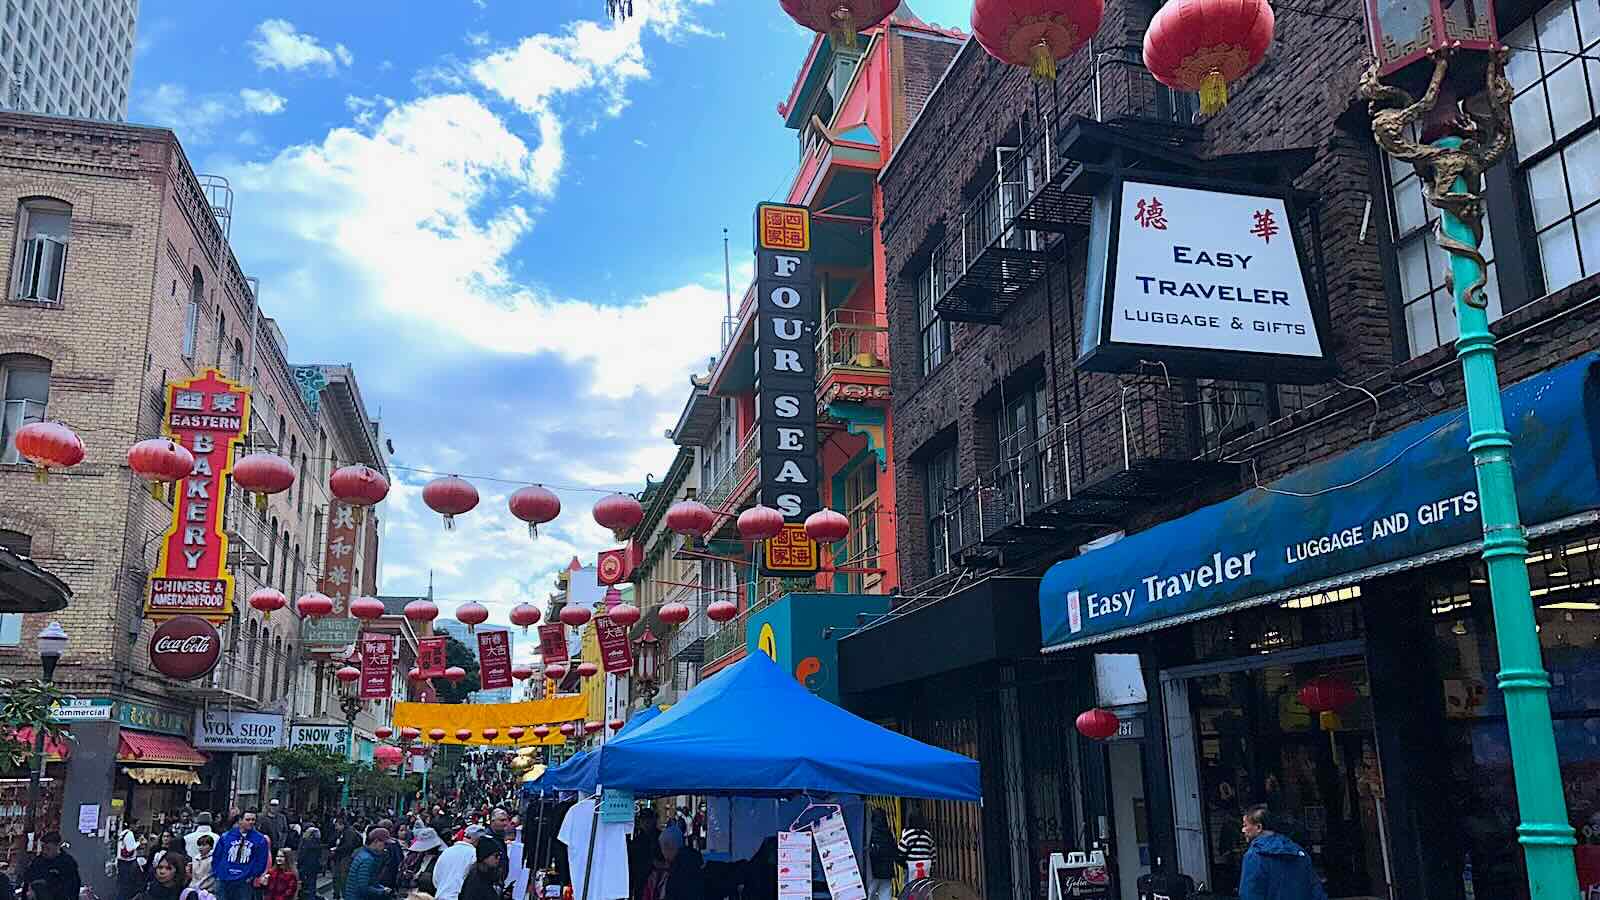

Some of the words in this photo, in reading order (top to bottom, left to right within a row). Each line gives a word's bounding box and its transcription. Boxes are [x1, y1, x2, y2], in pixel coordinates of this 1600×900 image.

[1134, 196, 1168, 231] 德
[1249, 208, 1280, 244] 華
[1173, 245, 1253, 270] EASY
[1135, 275, 1290, 306] TRAVELER
[770, 255, 803, 373] FOUR
[1124, 308, 1221, 328] LUGGAGE
[1230, 317, 1244, 330] &
[1253, 319, 1306, 335] GIFTS
[170, 414, 241, 429] EASTERN
[774, 395, 808, 517] SEAS
[182, 431, 215, 570] BAKERY
[1285, 525, 1365, 564] LUGGAGE
[1371, 511, 1410, 541] AND
[1417, 490, 1478, 526] GIFTS
[153, 580, 211, 593] CHINESE
[213, 581, 224, 593] &
[1087, 588, 1136, 620] Easy
[1142, 548, 1259, 603] Traveler
[153, 593, 200, 606] AMERICAN
[200, 594, 223, 606] FOOD
[604, 625, 626, 640] 大吉
[369, 654, 390, 665] 大吉
[486, 644, 507, 657] 大吉
[53, 708, 105, 716] Commercial
[203, 721, 234, 736] WOK
[240, 723, 276, 738] SHOP
[297, 728, 330, 742] SNOW
